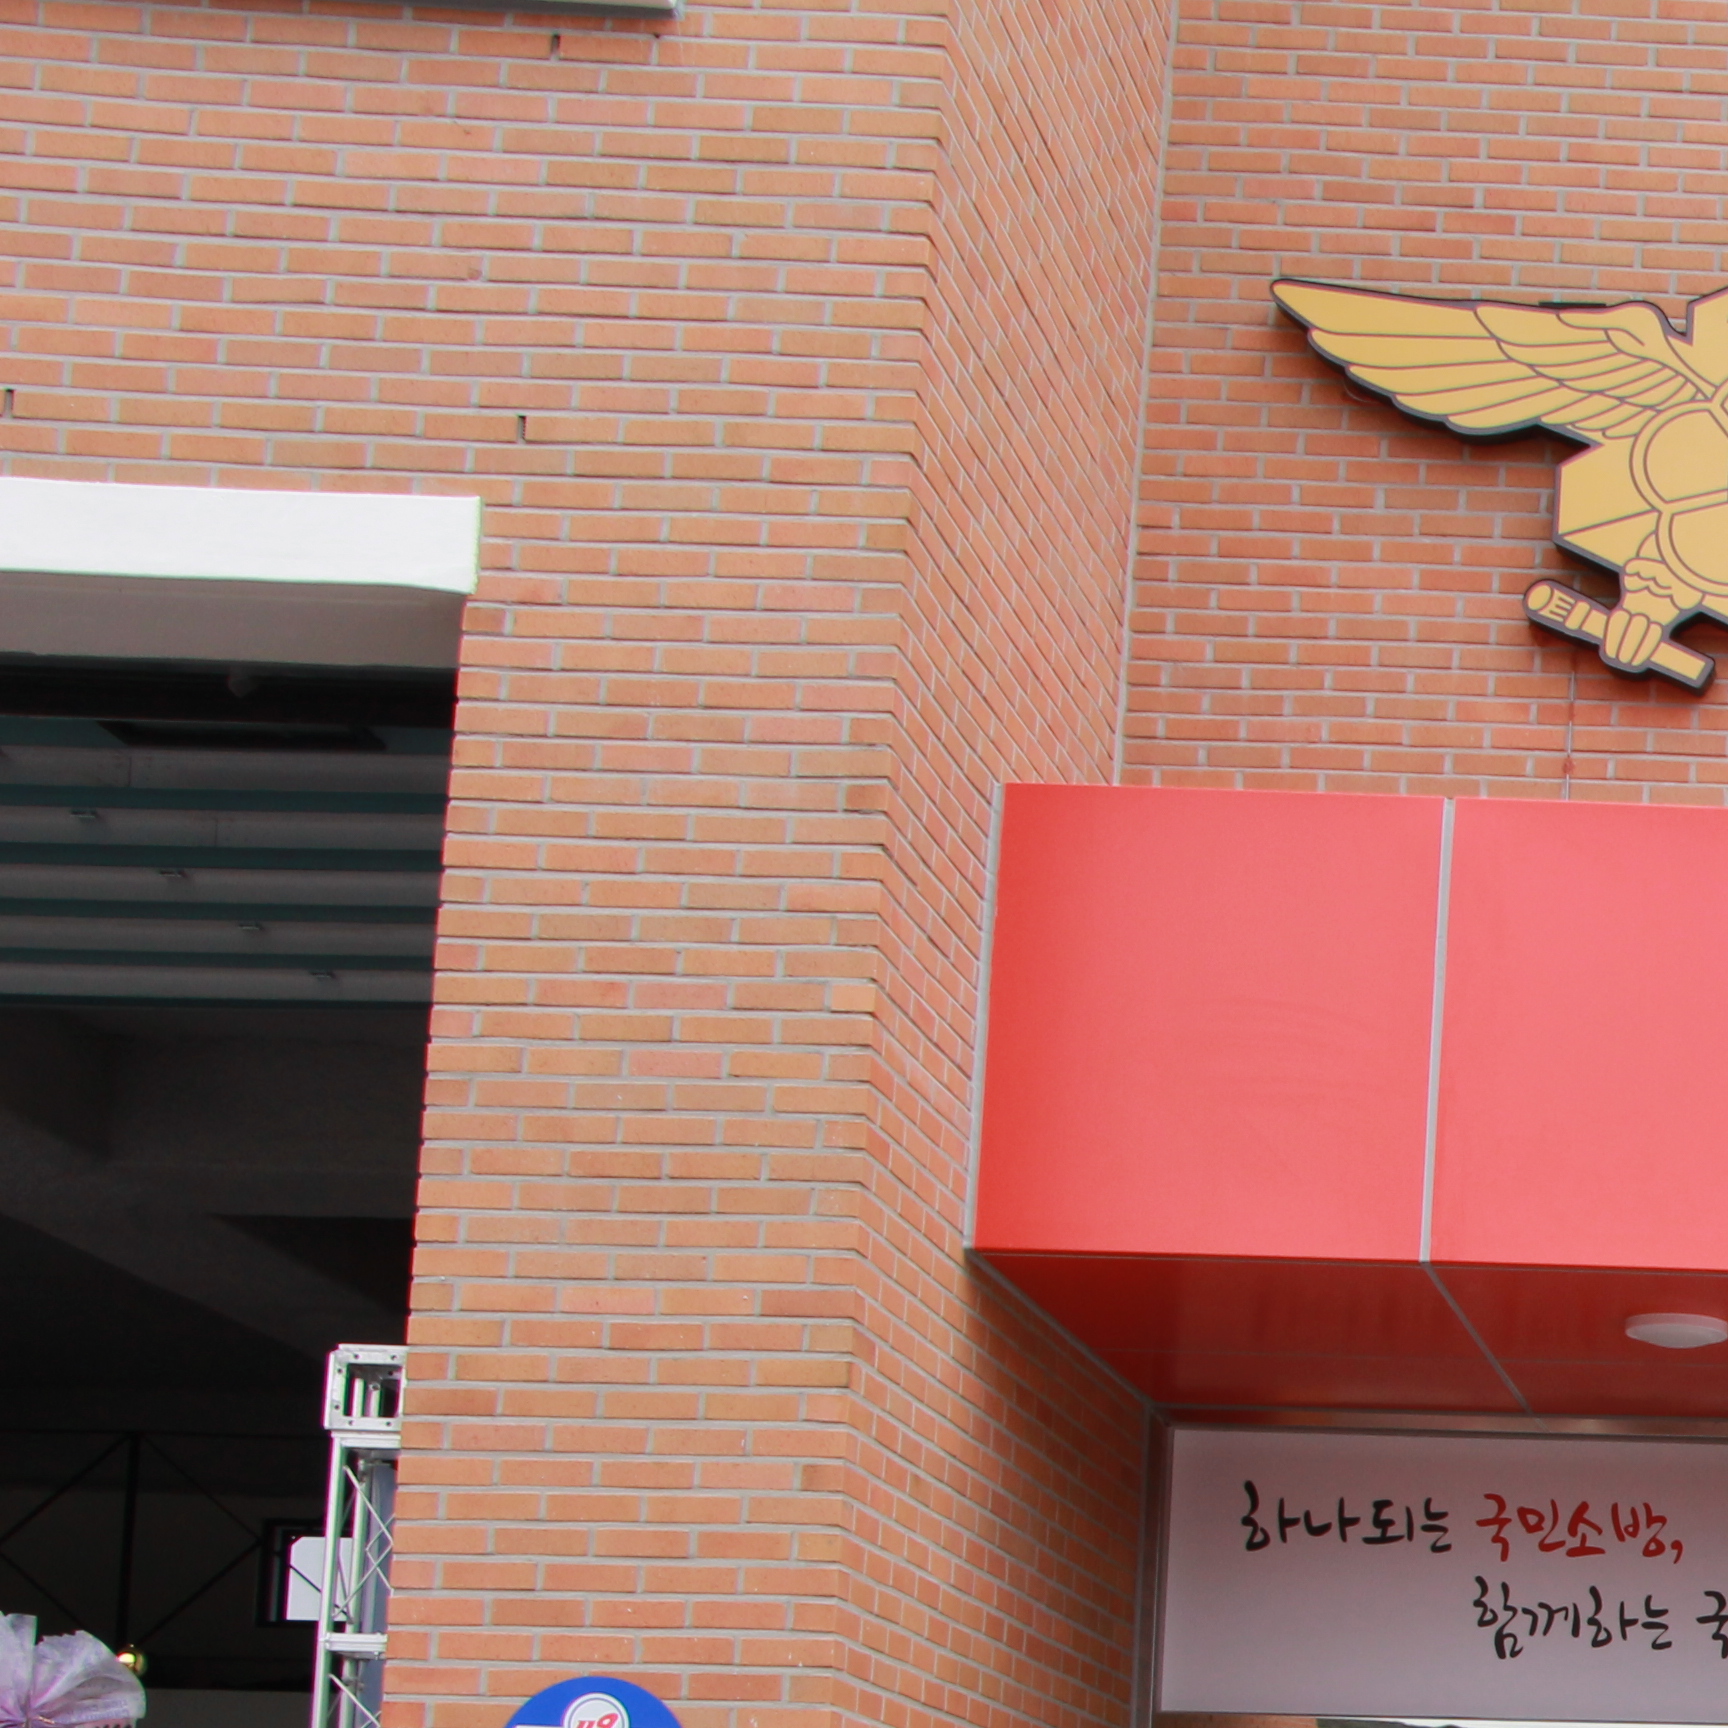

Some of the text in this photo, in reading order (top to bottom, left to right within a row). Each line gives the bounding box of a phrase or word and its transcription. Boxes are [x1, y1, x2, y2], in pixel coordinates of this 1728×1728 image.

[1239, 1480, 1685, 1564] 하나되는 국민소방,
[1472, 1575, 1673, 1660] 함께하는
